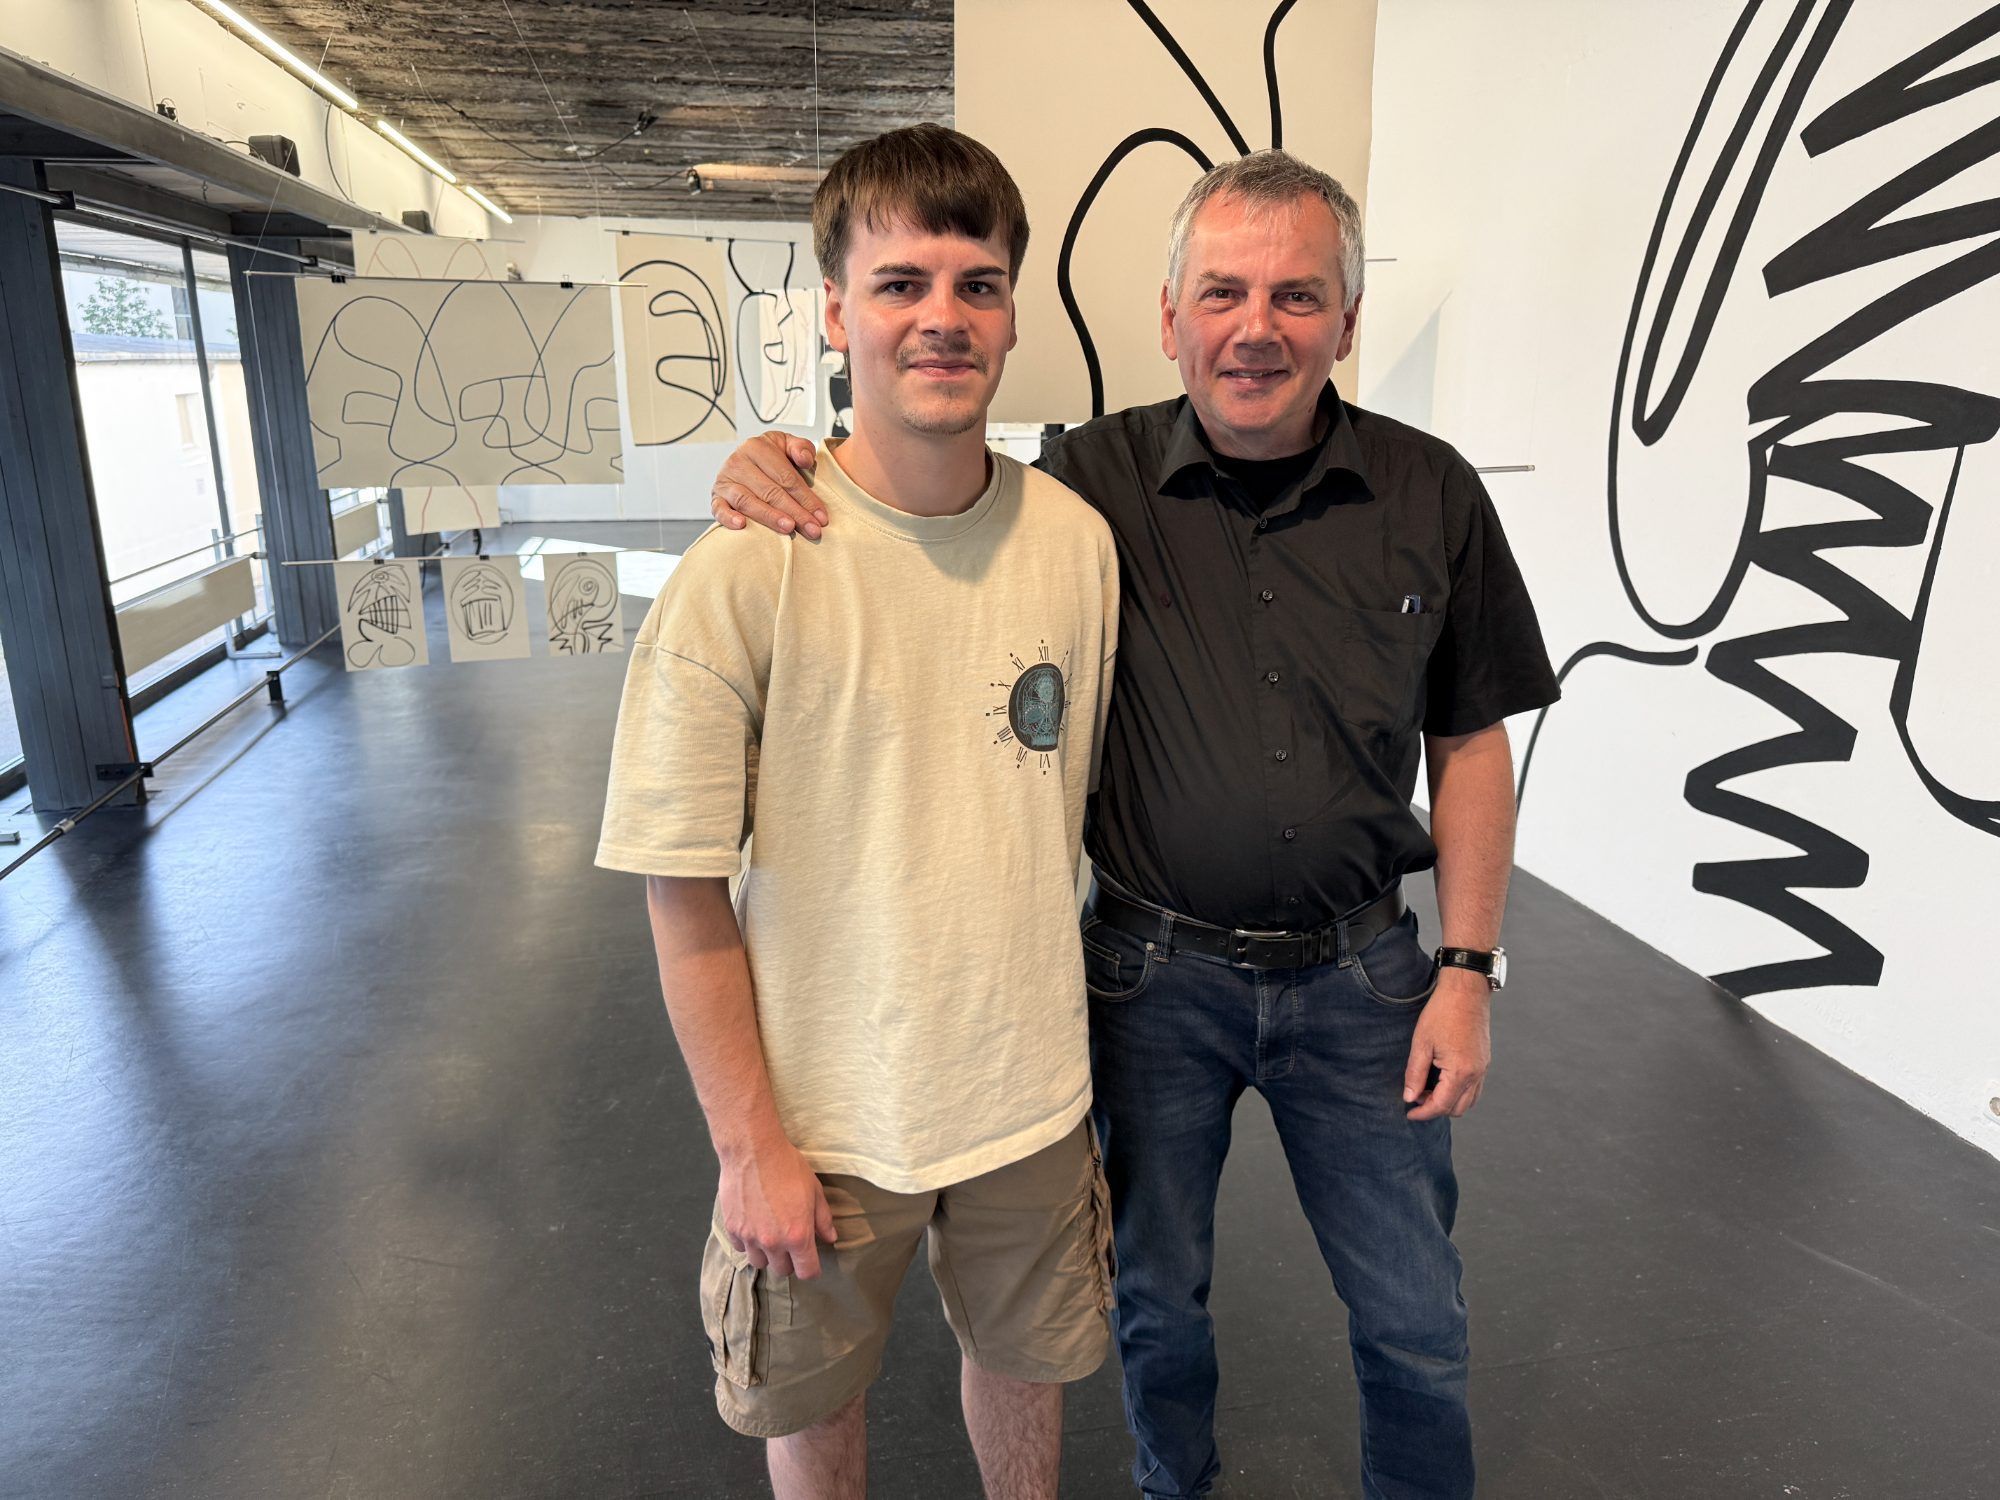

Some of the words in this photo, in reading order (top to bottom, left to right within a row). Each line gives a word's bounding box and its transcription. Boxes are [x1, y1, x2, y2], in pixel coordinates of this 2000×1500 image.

[1038, 646, 1050, 661] XII
[1012, 657, 1025, 673] XI
[998, 680, 1011, 691] X
[993, 705, 1007, 715] IX
[1039, 753, 1051, 769] VI
